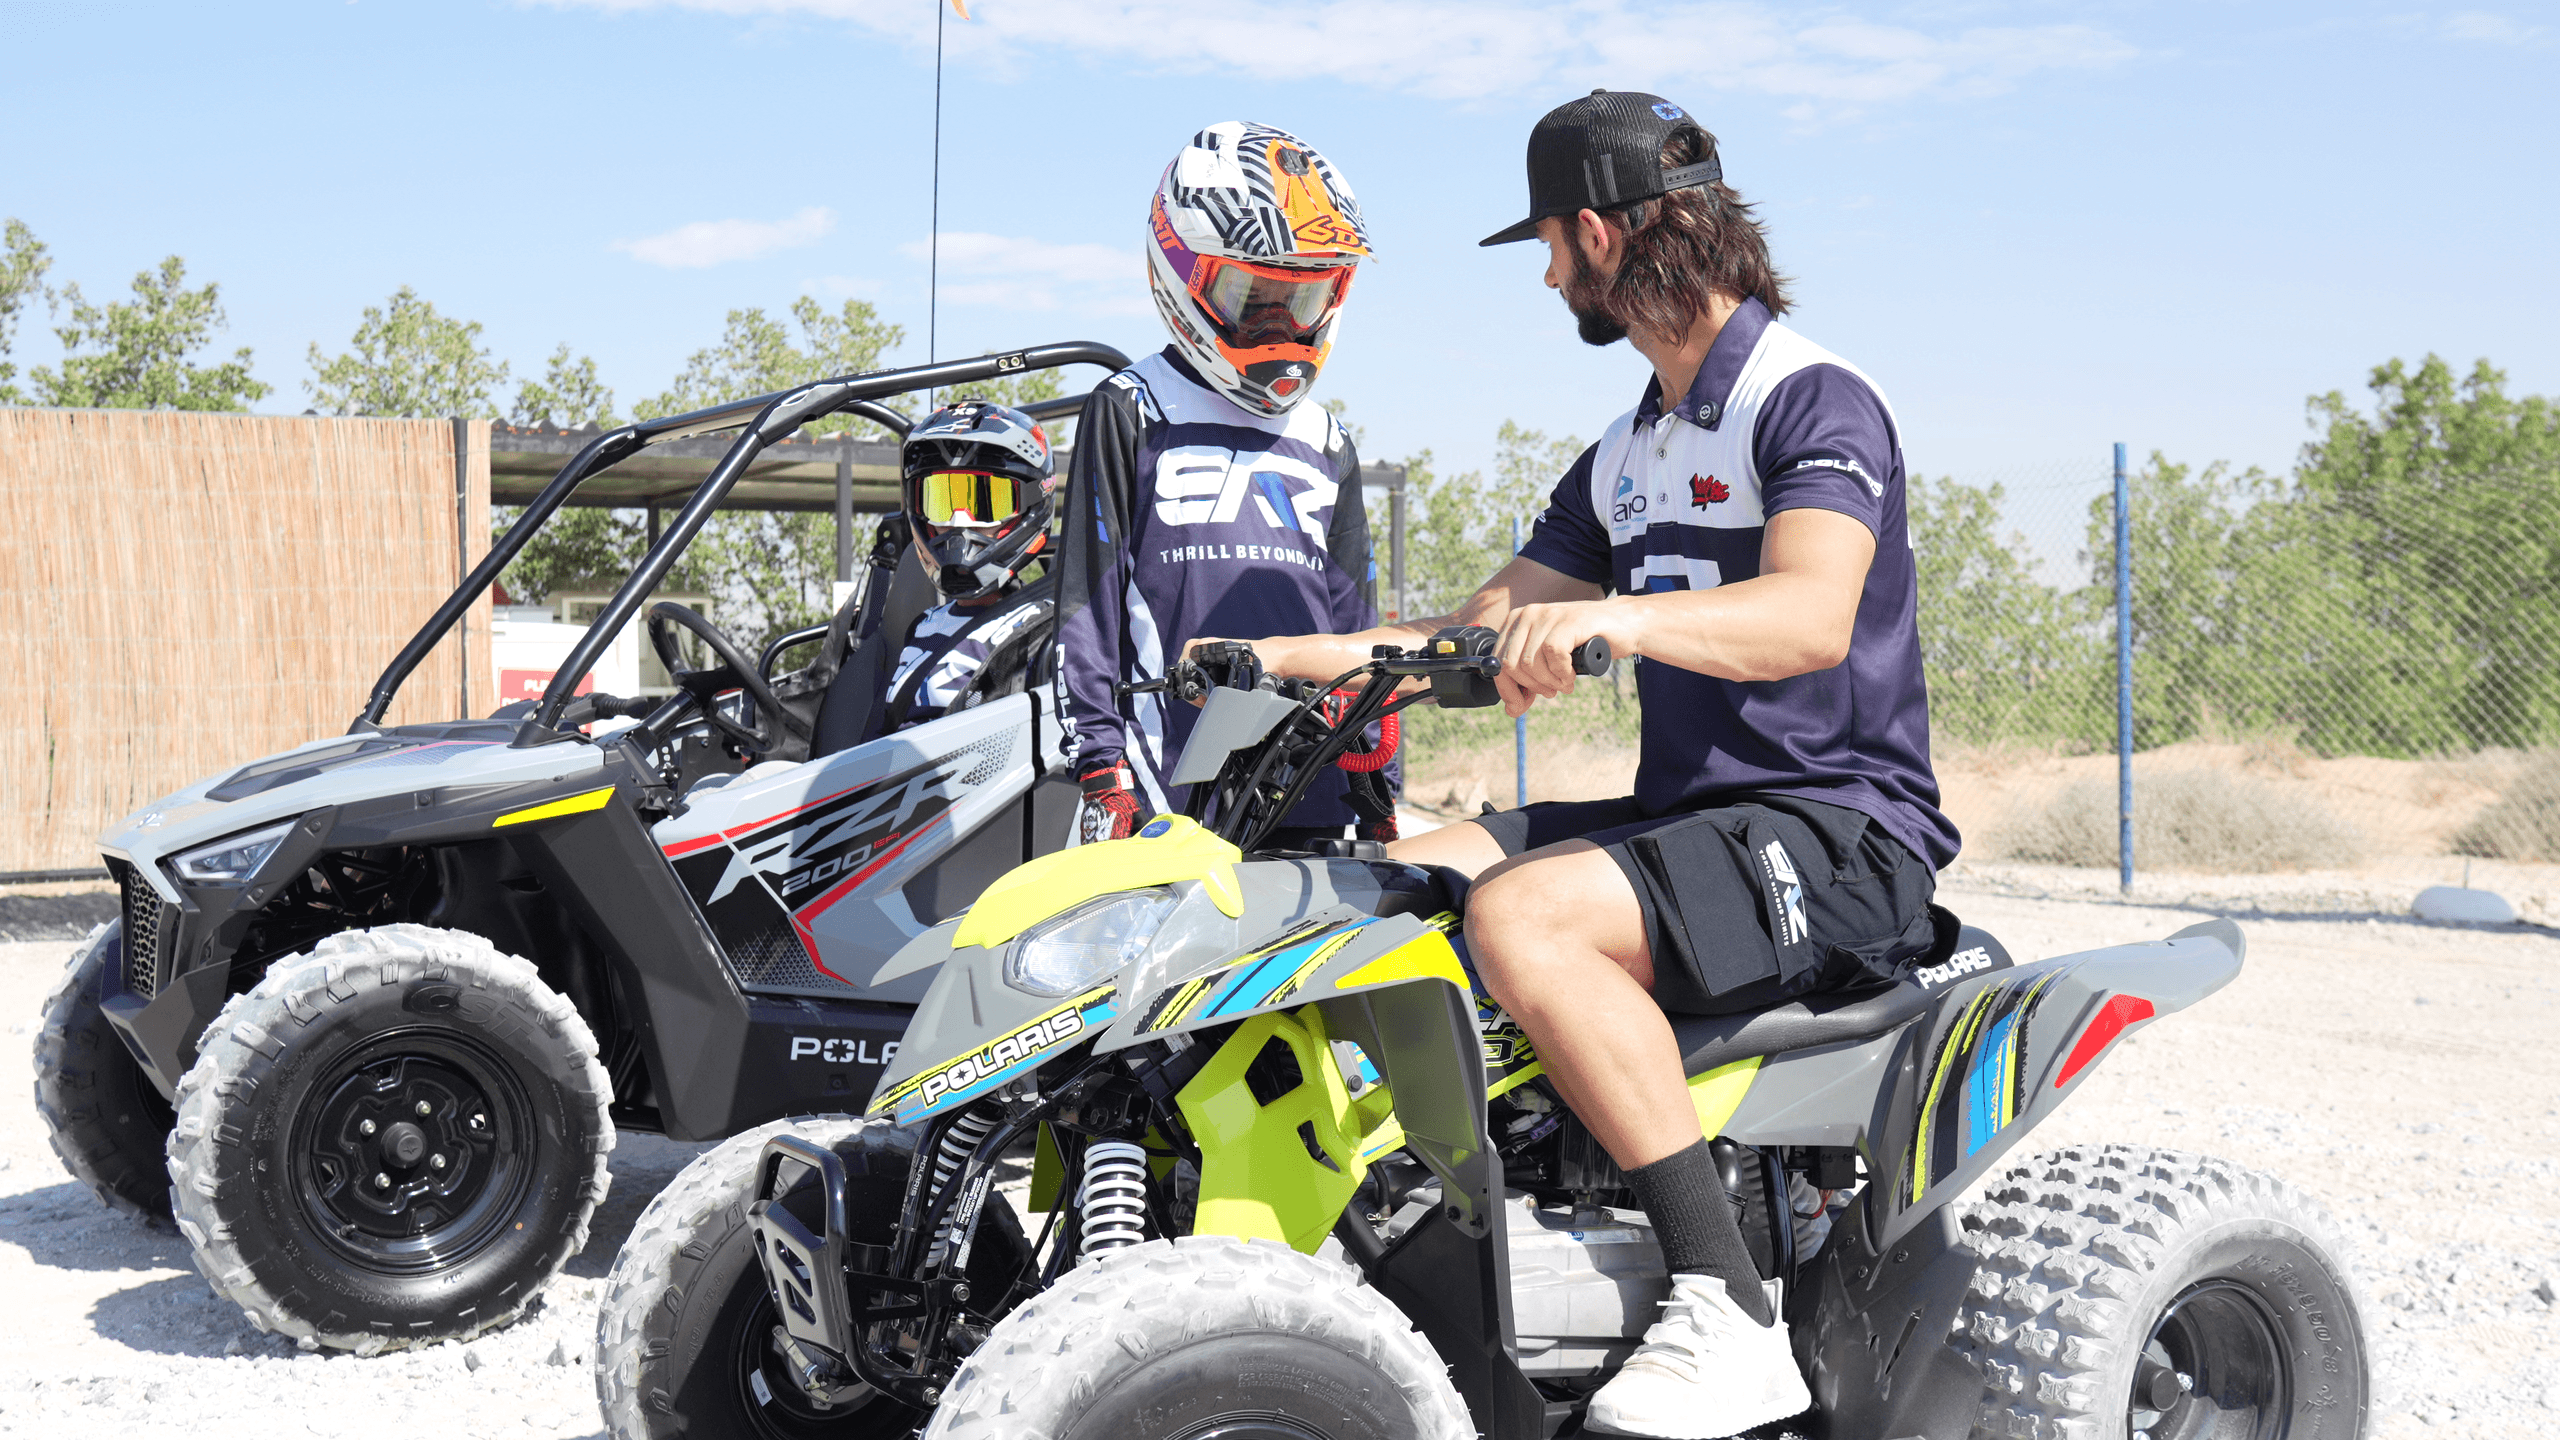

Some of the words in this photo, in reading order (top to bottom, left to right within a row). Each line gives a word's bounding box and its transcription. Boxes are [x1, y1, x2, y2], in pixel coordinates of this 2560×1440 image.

[1160, 544, 1231, 564] THRILL
[1236, 544, 1305, 565] BEYOND
[706, 752, 988, 905] RZR
[782, 843, 872, 897] 200
[1758, 849, 1774, 879] THRILL
[1770, 882, 1785, 915] BEYOND
[1780, 917, 1790, 947] LIMITS
[1918, 946, 1992, 990] POLARIS
[790, 1036, 901, 1065] POLA
[921, 1008, 1082, 1106] POLARIS
[911, 1155, 929, 1196] POLARIS
